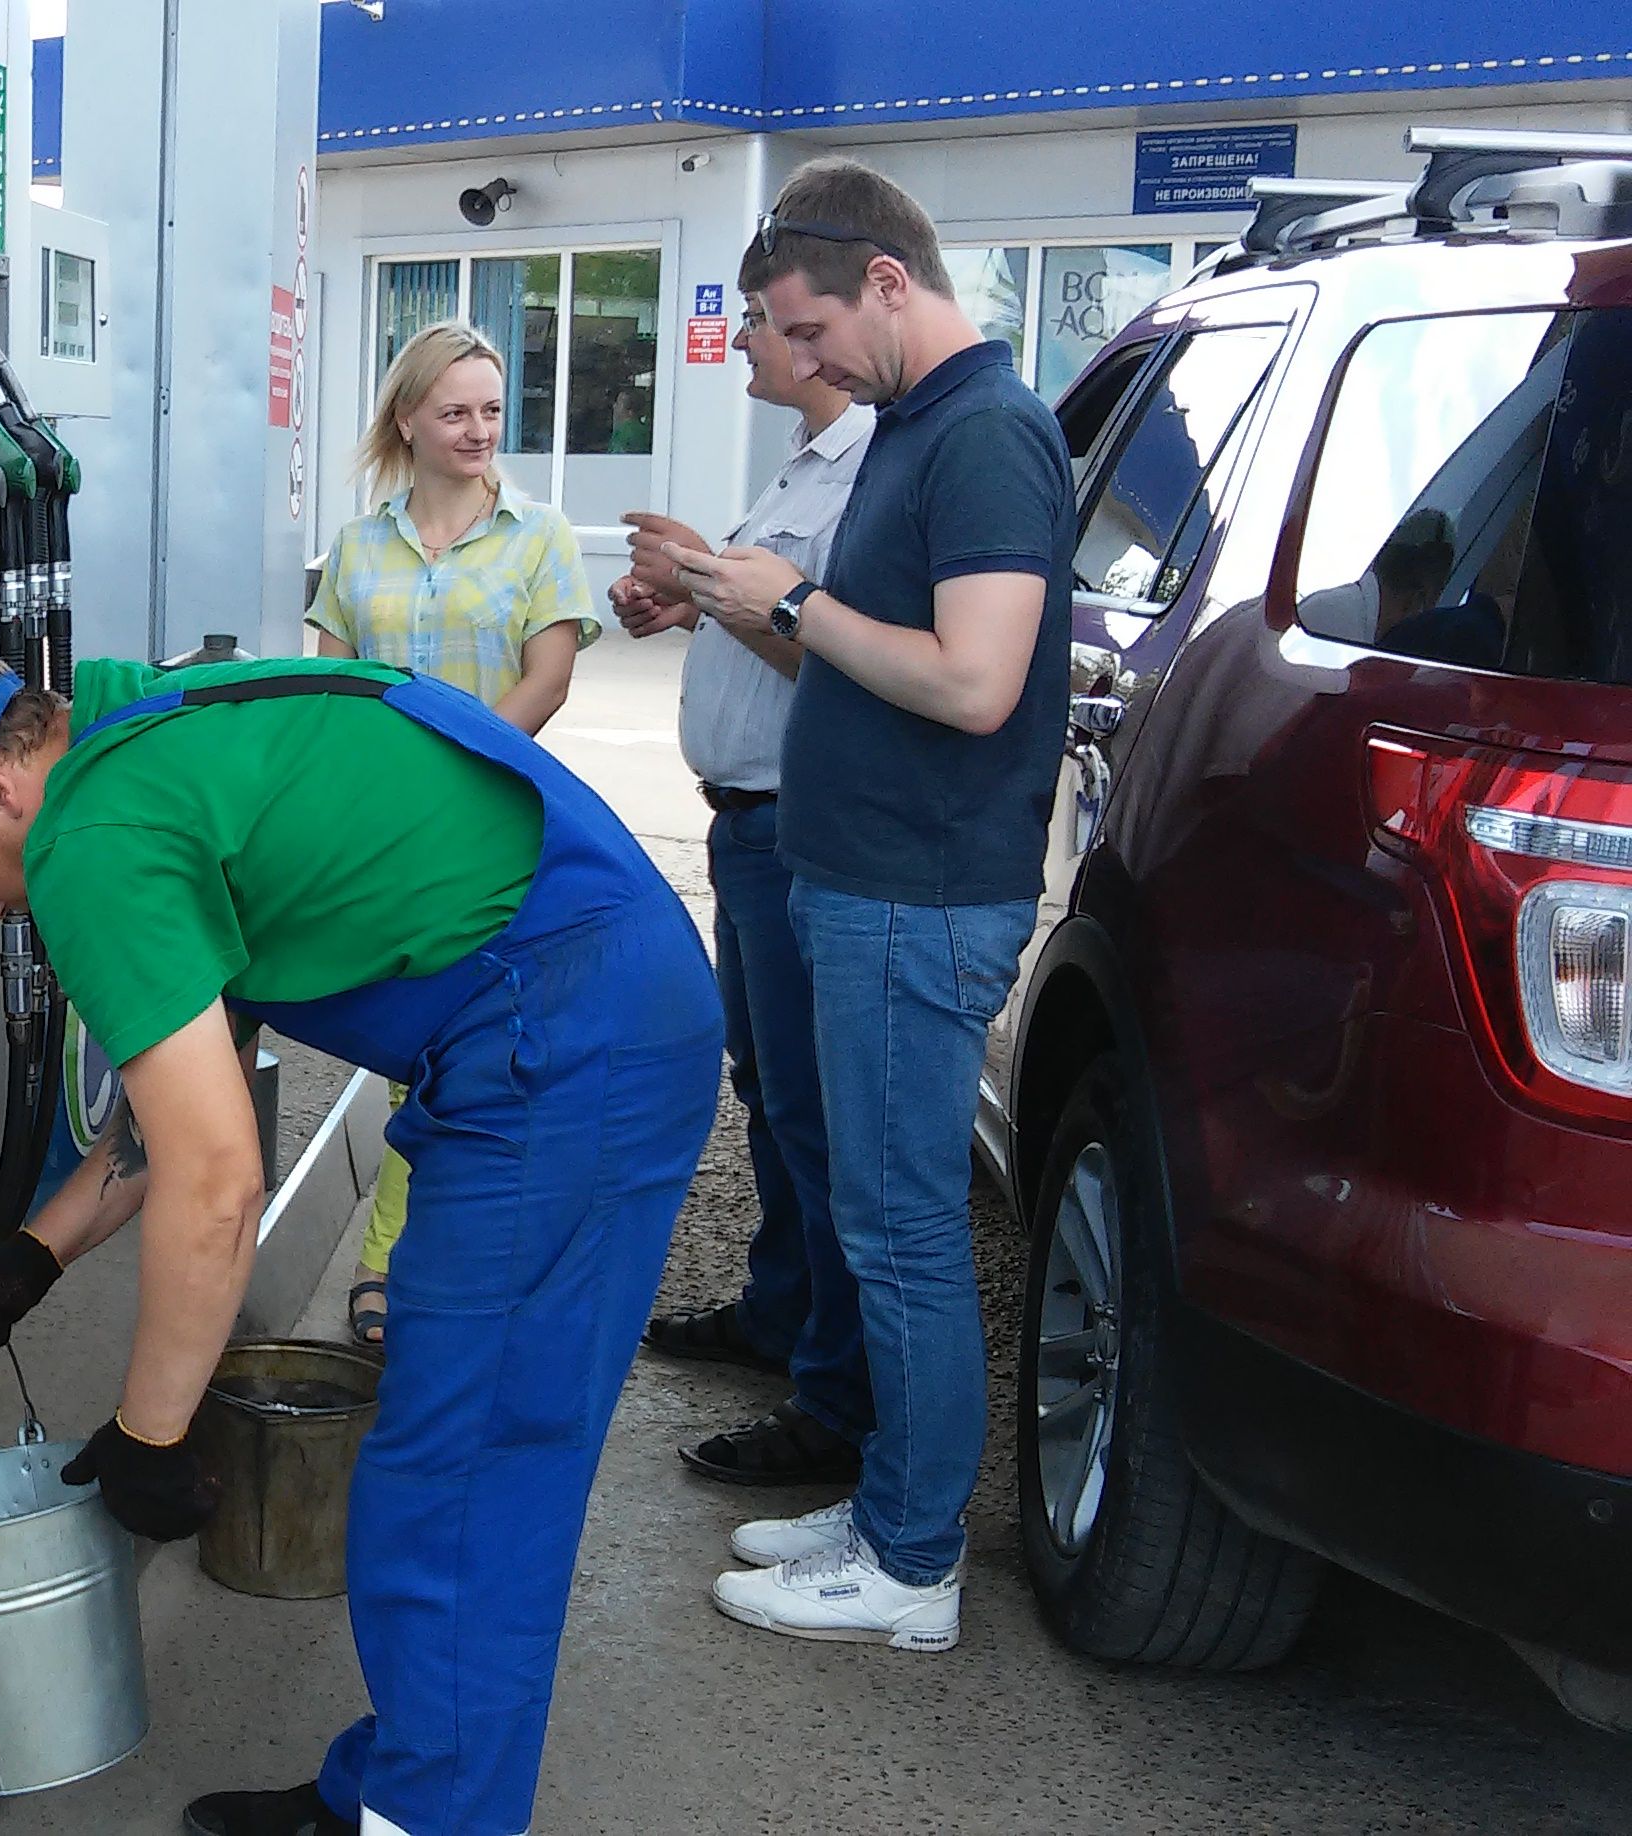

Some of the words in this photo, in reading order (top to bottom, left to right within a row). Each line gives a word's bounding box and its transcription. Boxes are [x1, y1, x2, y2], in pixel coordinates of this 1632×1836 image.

[1171, 153, 1259, 168] ЗАПРЕЩЕНА!
[1155, 189, 1171, 201] НЕ
[1173, 186, 1247, 200] ПРОИЗВОДИ
[1062, 271, 1107, 302] BO
[911, 1635, 949, 1644] Reebok
